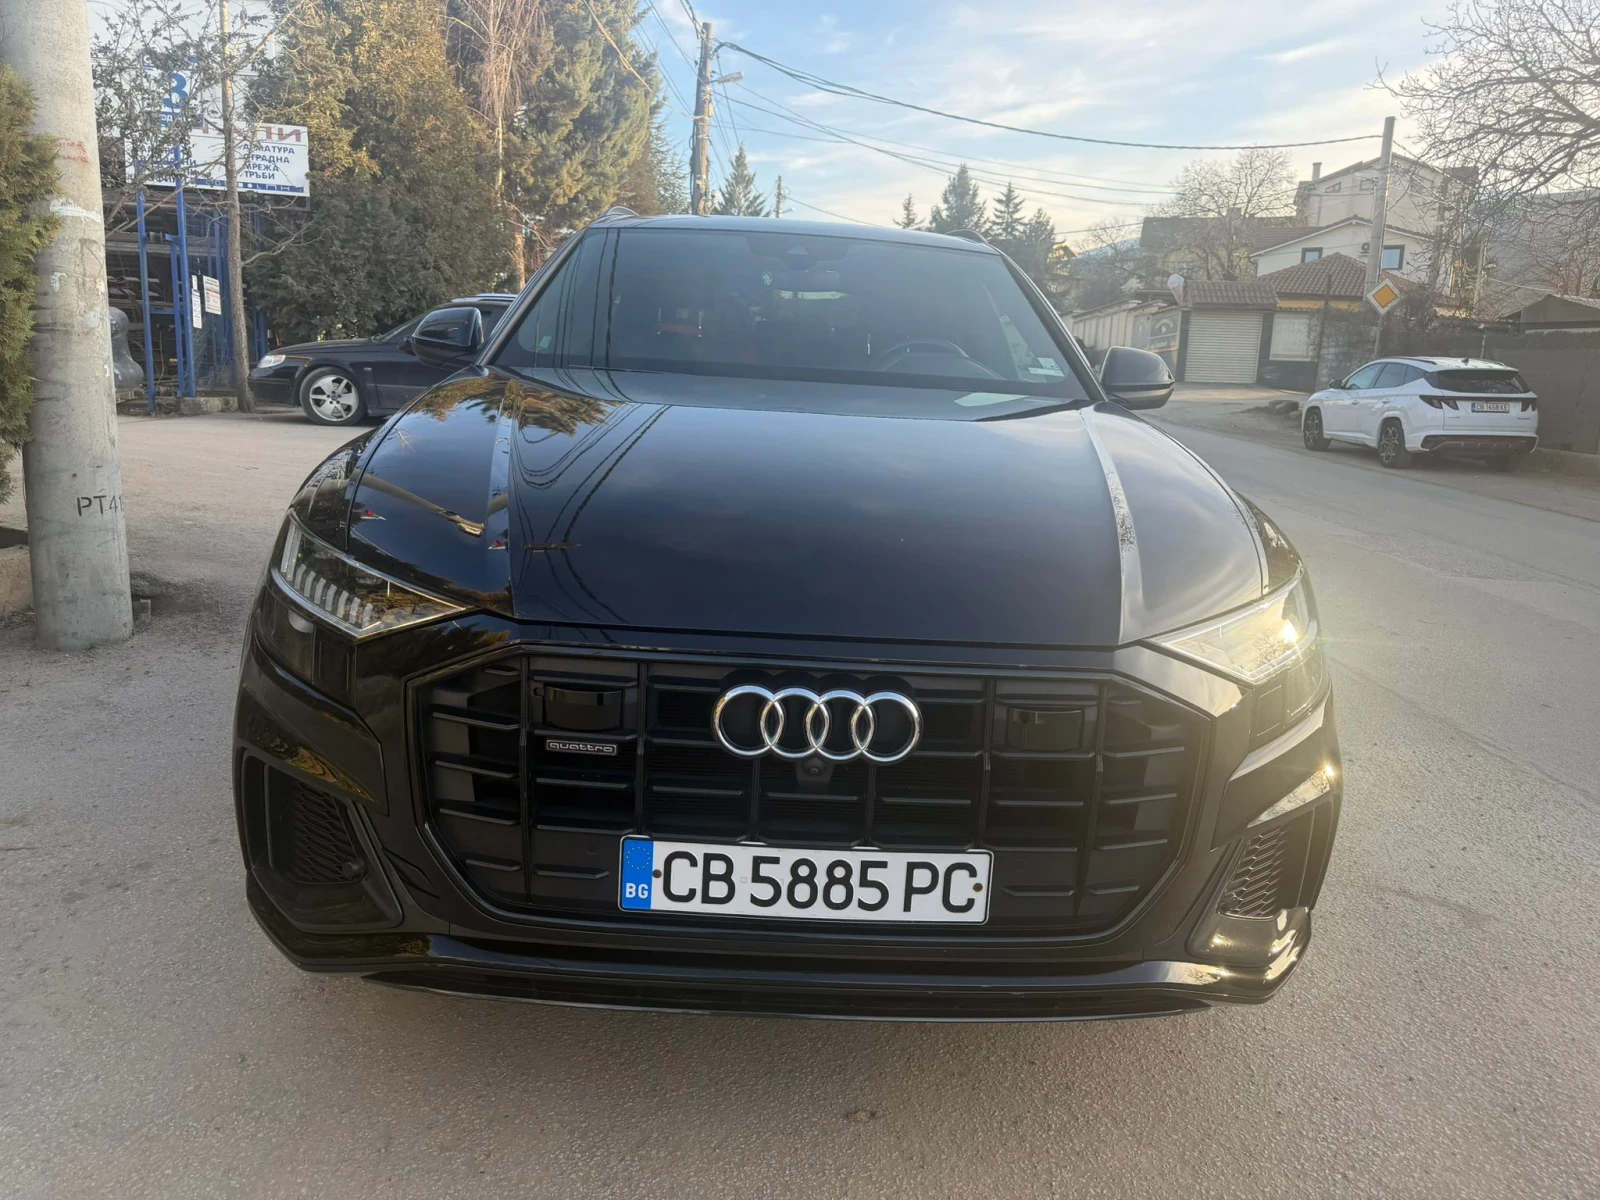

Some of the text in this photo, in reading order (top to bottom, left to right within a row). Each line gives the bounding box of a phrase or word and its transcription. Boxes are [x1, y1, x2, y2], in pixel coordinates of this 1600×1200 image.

[243, 143, 295, 154] АМАТУРА
[244, 171, 275, 180] ТРЪБИ
[549, 742, 613, 752] quattro
[662, 850, 978, 913] CB 5885 PC
[625, 882, 649, 899] BG
